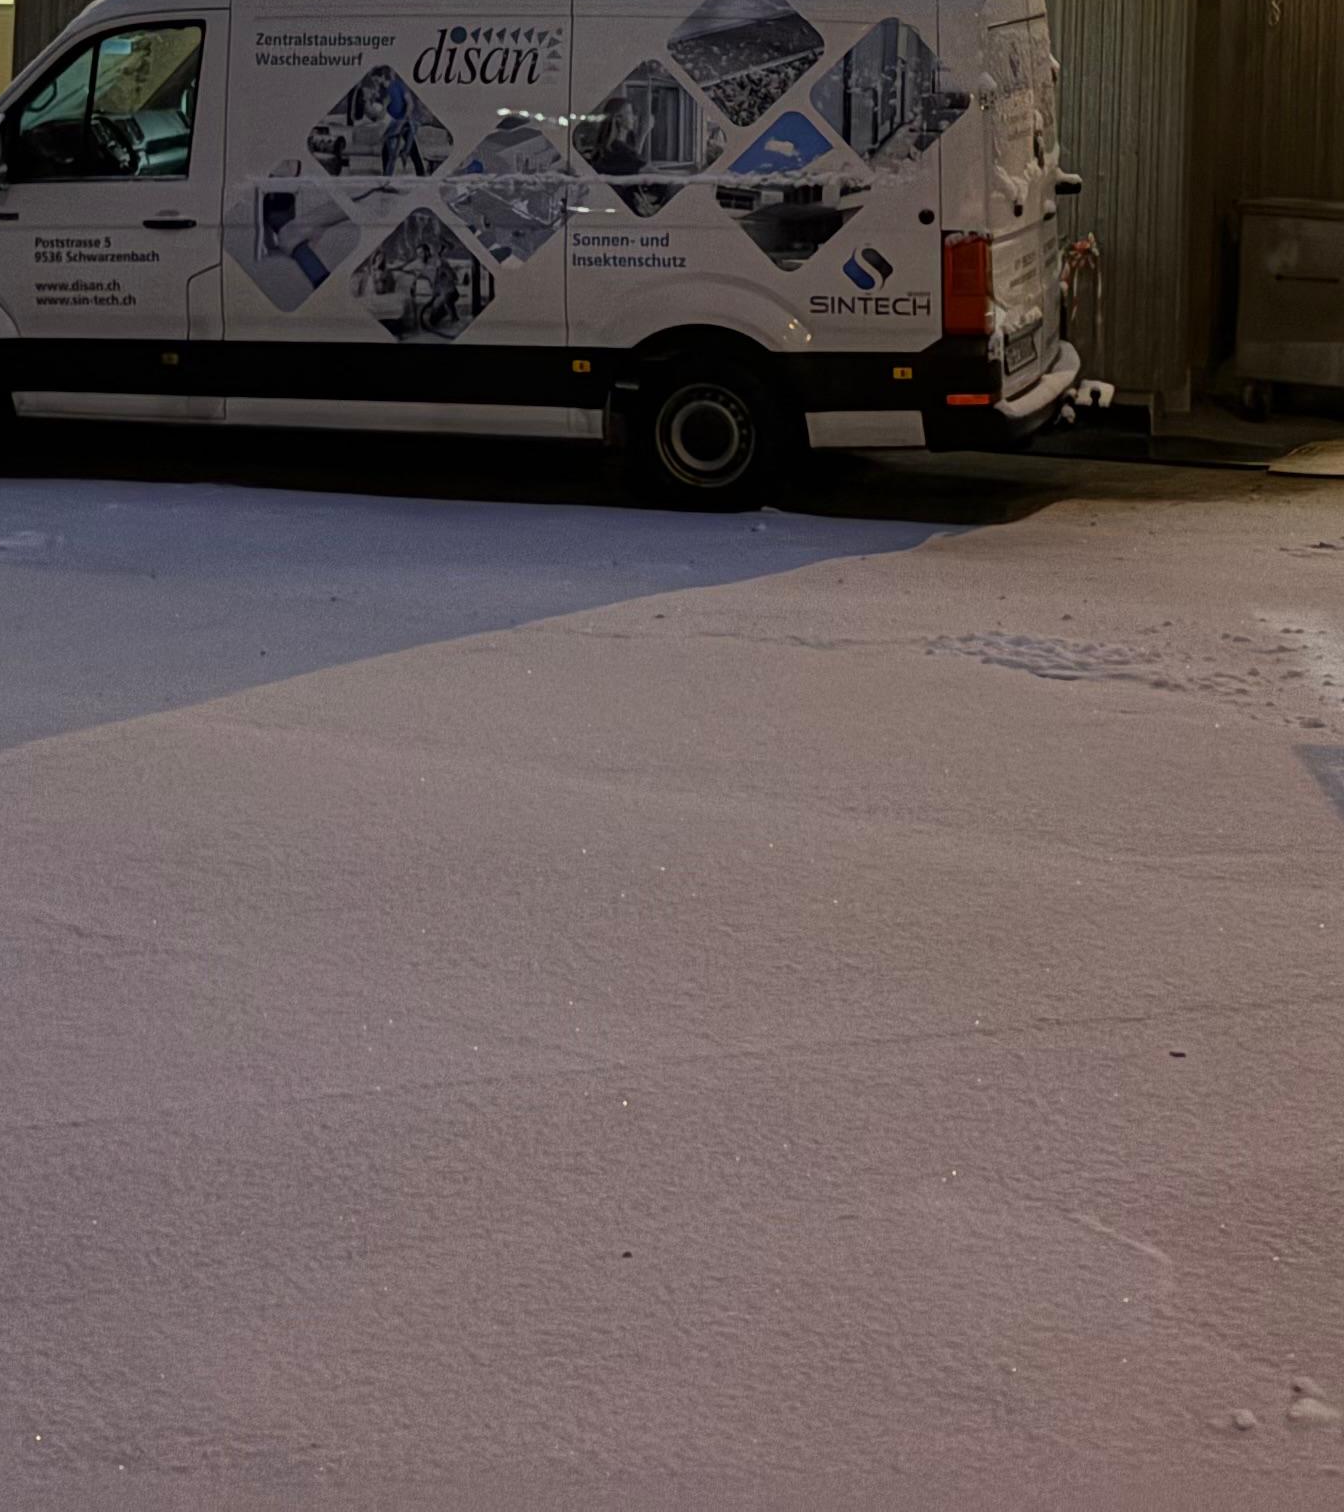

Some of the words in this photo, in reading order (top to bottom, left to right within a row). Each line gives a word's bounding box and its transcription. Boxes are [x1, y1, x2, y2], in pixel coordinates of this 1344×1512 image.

[255, 32, 396, 49] Zentralstaubsauger
[412, 26, 540, 86] disan
[35, 236, 101, 248] Poststrasse
[103, 236, 112, 248] 5
[572, 232, 635, 247] Sonnen-
[640, 232, 670, 247] und
[34, 251, 63, 263] 9536
[65, 250, 160, 263] Schwarzenbach
[572, 253, 687, 268] Insektenschutz
[35, 279, 121, 292] www.disan.ch
[809, 295, 931, 317] SINTECH
